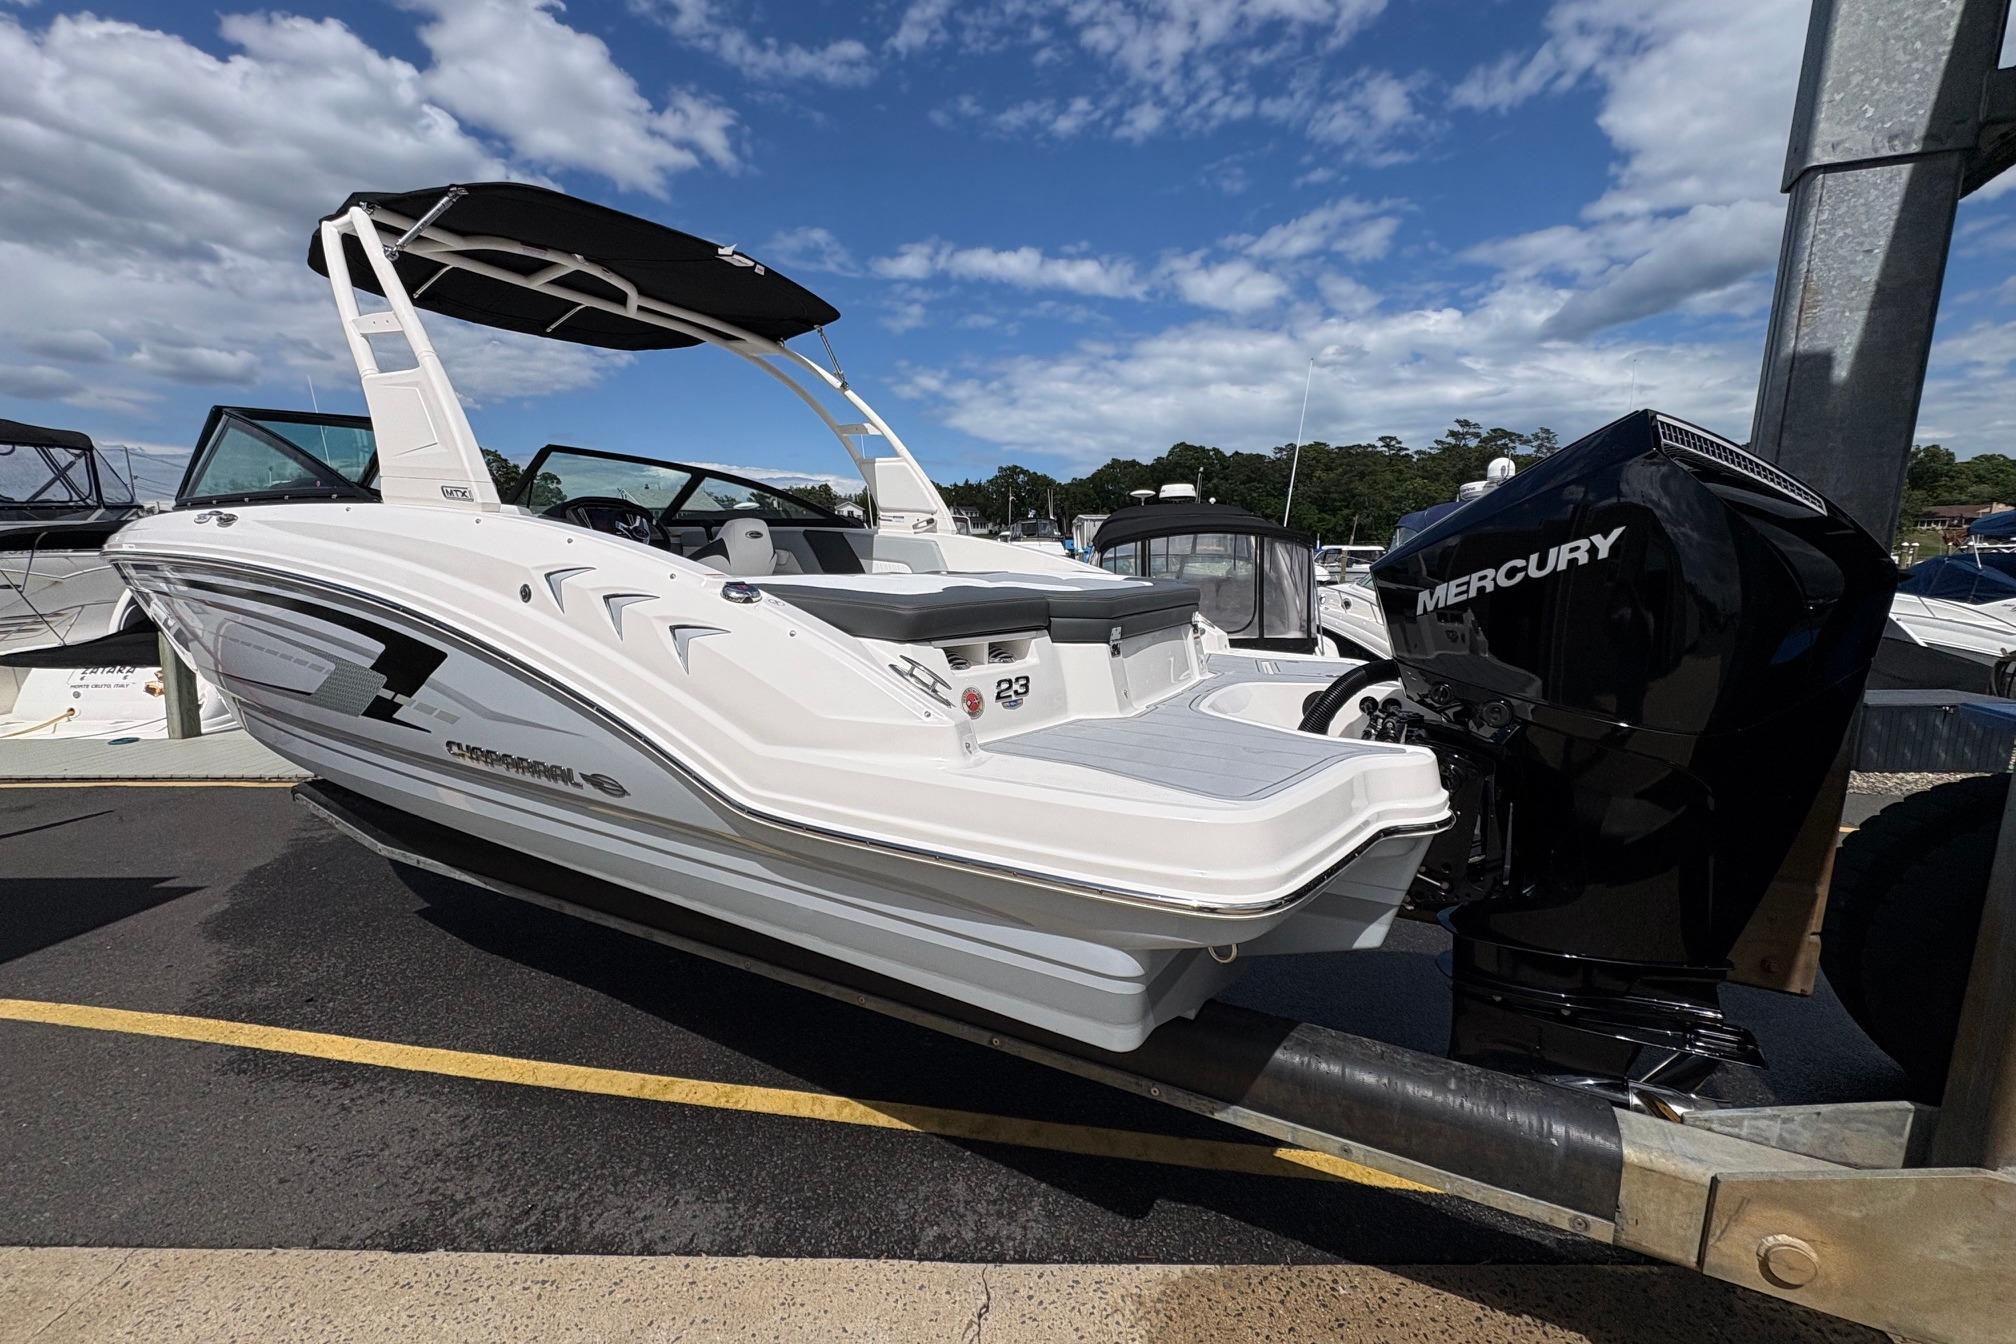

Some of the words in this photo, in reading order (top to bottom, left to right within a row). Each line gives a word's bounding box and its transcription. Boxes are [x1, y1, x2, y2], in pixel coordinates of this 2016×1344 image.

[1416, 525, 1627, 616] MERCURY
[995, 675, 1030, 703] 23
[445, 740, 584, 789] CHAPARRAL
